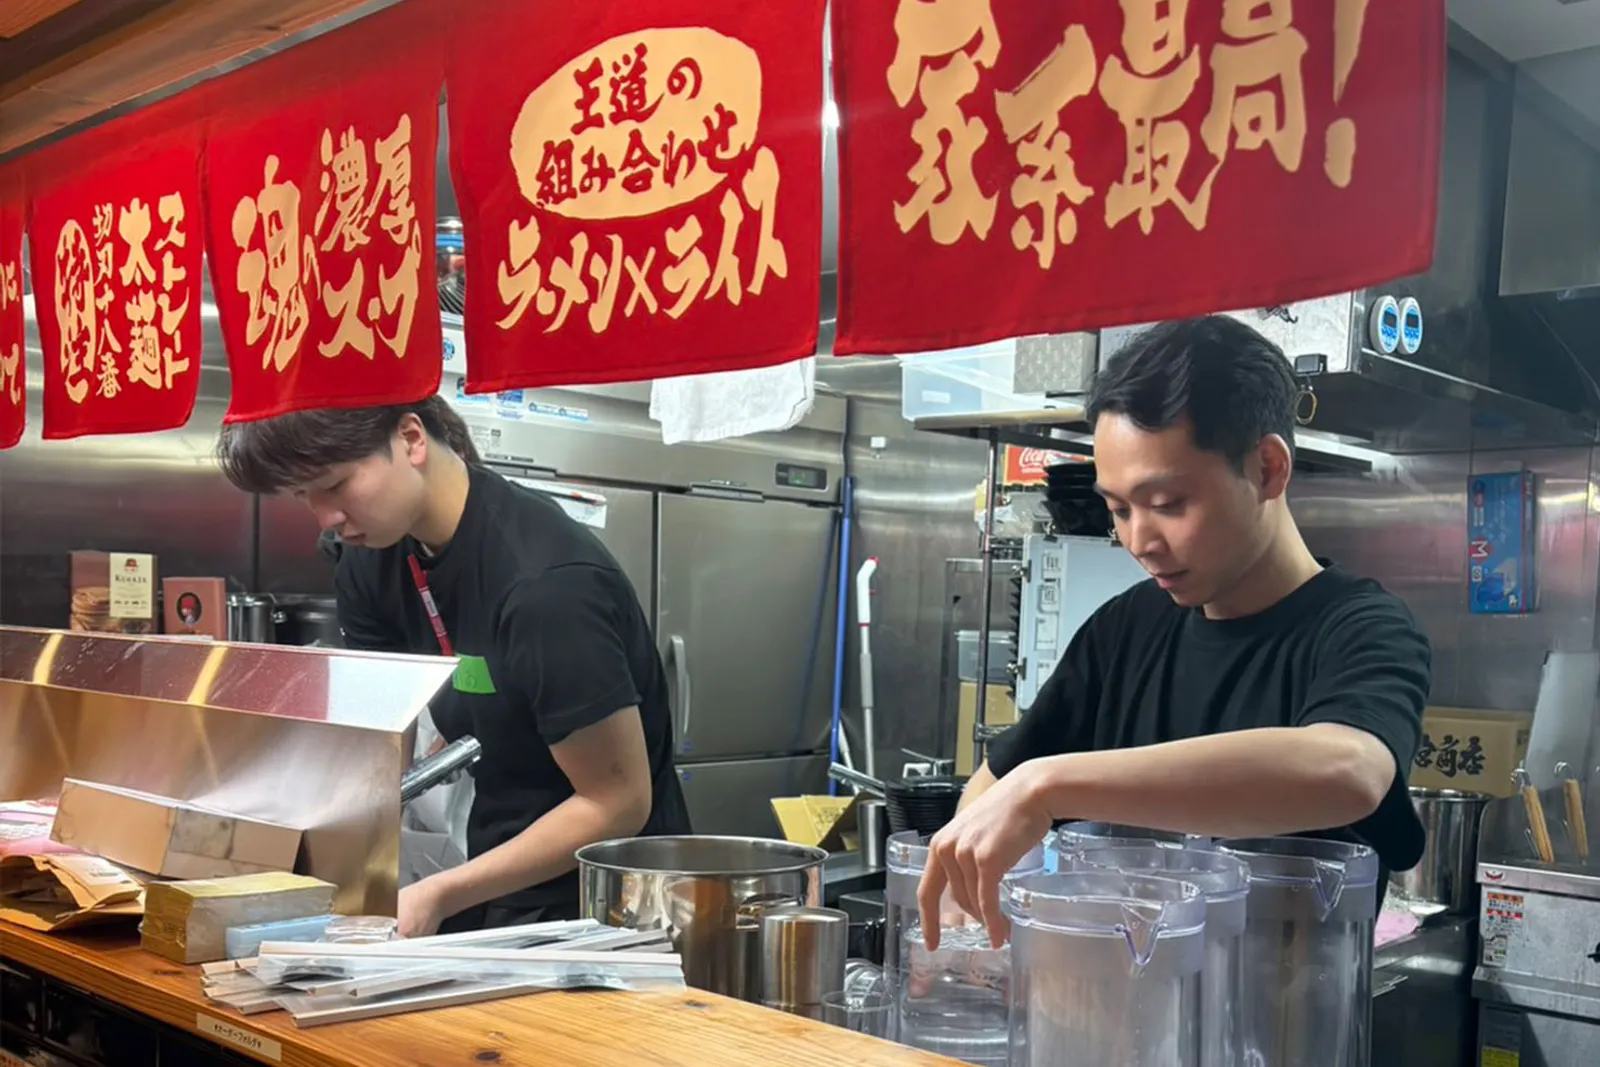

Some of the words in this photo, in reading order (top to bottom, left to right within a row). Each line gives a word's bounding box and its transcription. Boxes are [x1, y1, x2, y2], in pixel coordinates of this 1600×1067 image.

[535, 103, 747, 208] 組み合わせ
[571, 42, 703, 135] 王道の
[314, 113, 416, 253] 濃厚
[118, 197, 163, 390] 太麺
[153, 191, 190, 390] ストレート
